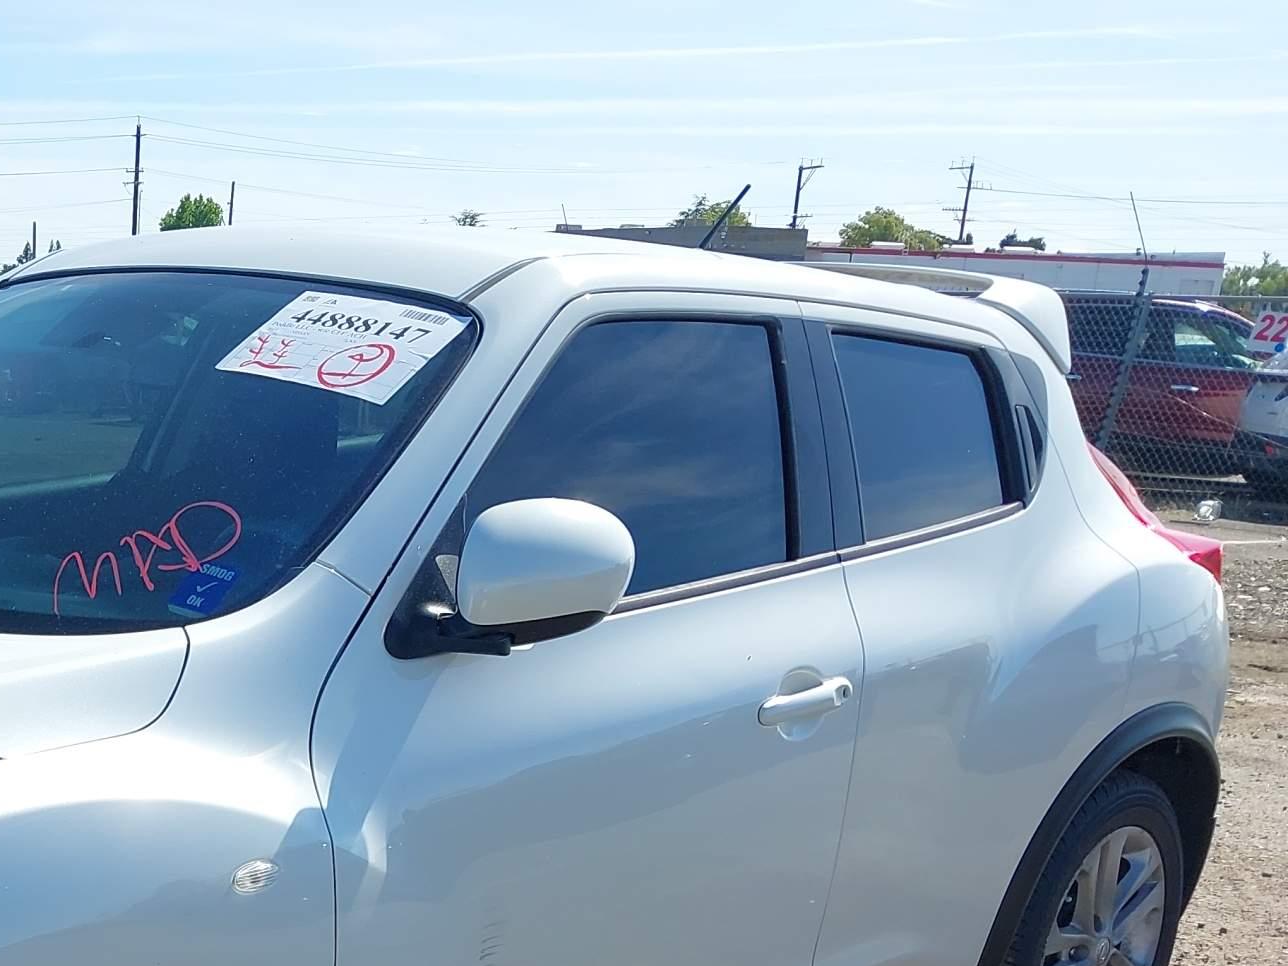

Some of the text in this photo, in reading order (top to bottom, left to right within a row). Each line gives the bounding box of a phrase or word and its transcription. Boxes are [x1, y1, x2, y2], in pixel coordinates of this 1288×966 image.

[291, 309, 432, 343] 44888147
[200, 563, 235, 581] SMOG
[186, 594, 205, 607] OK
